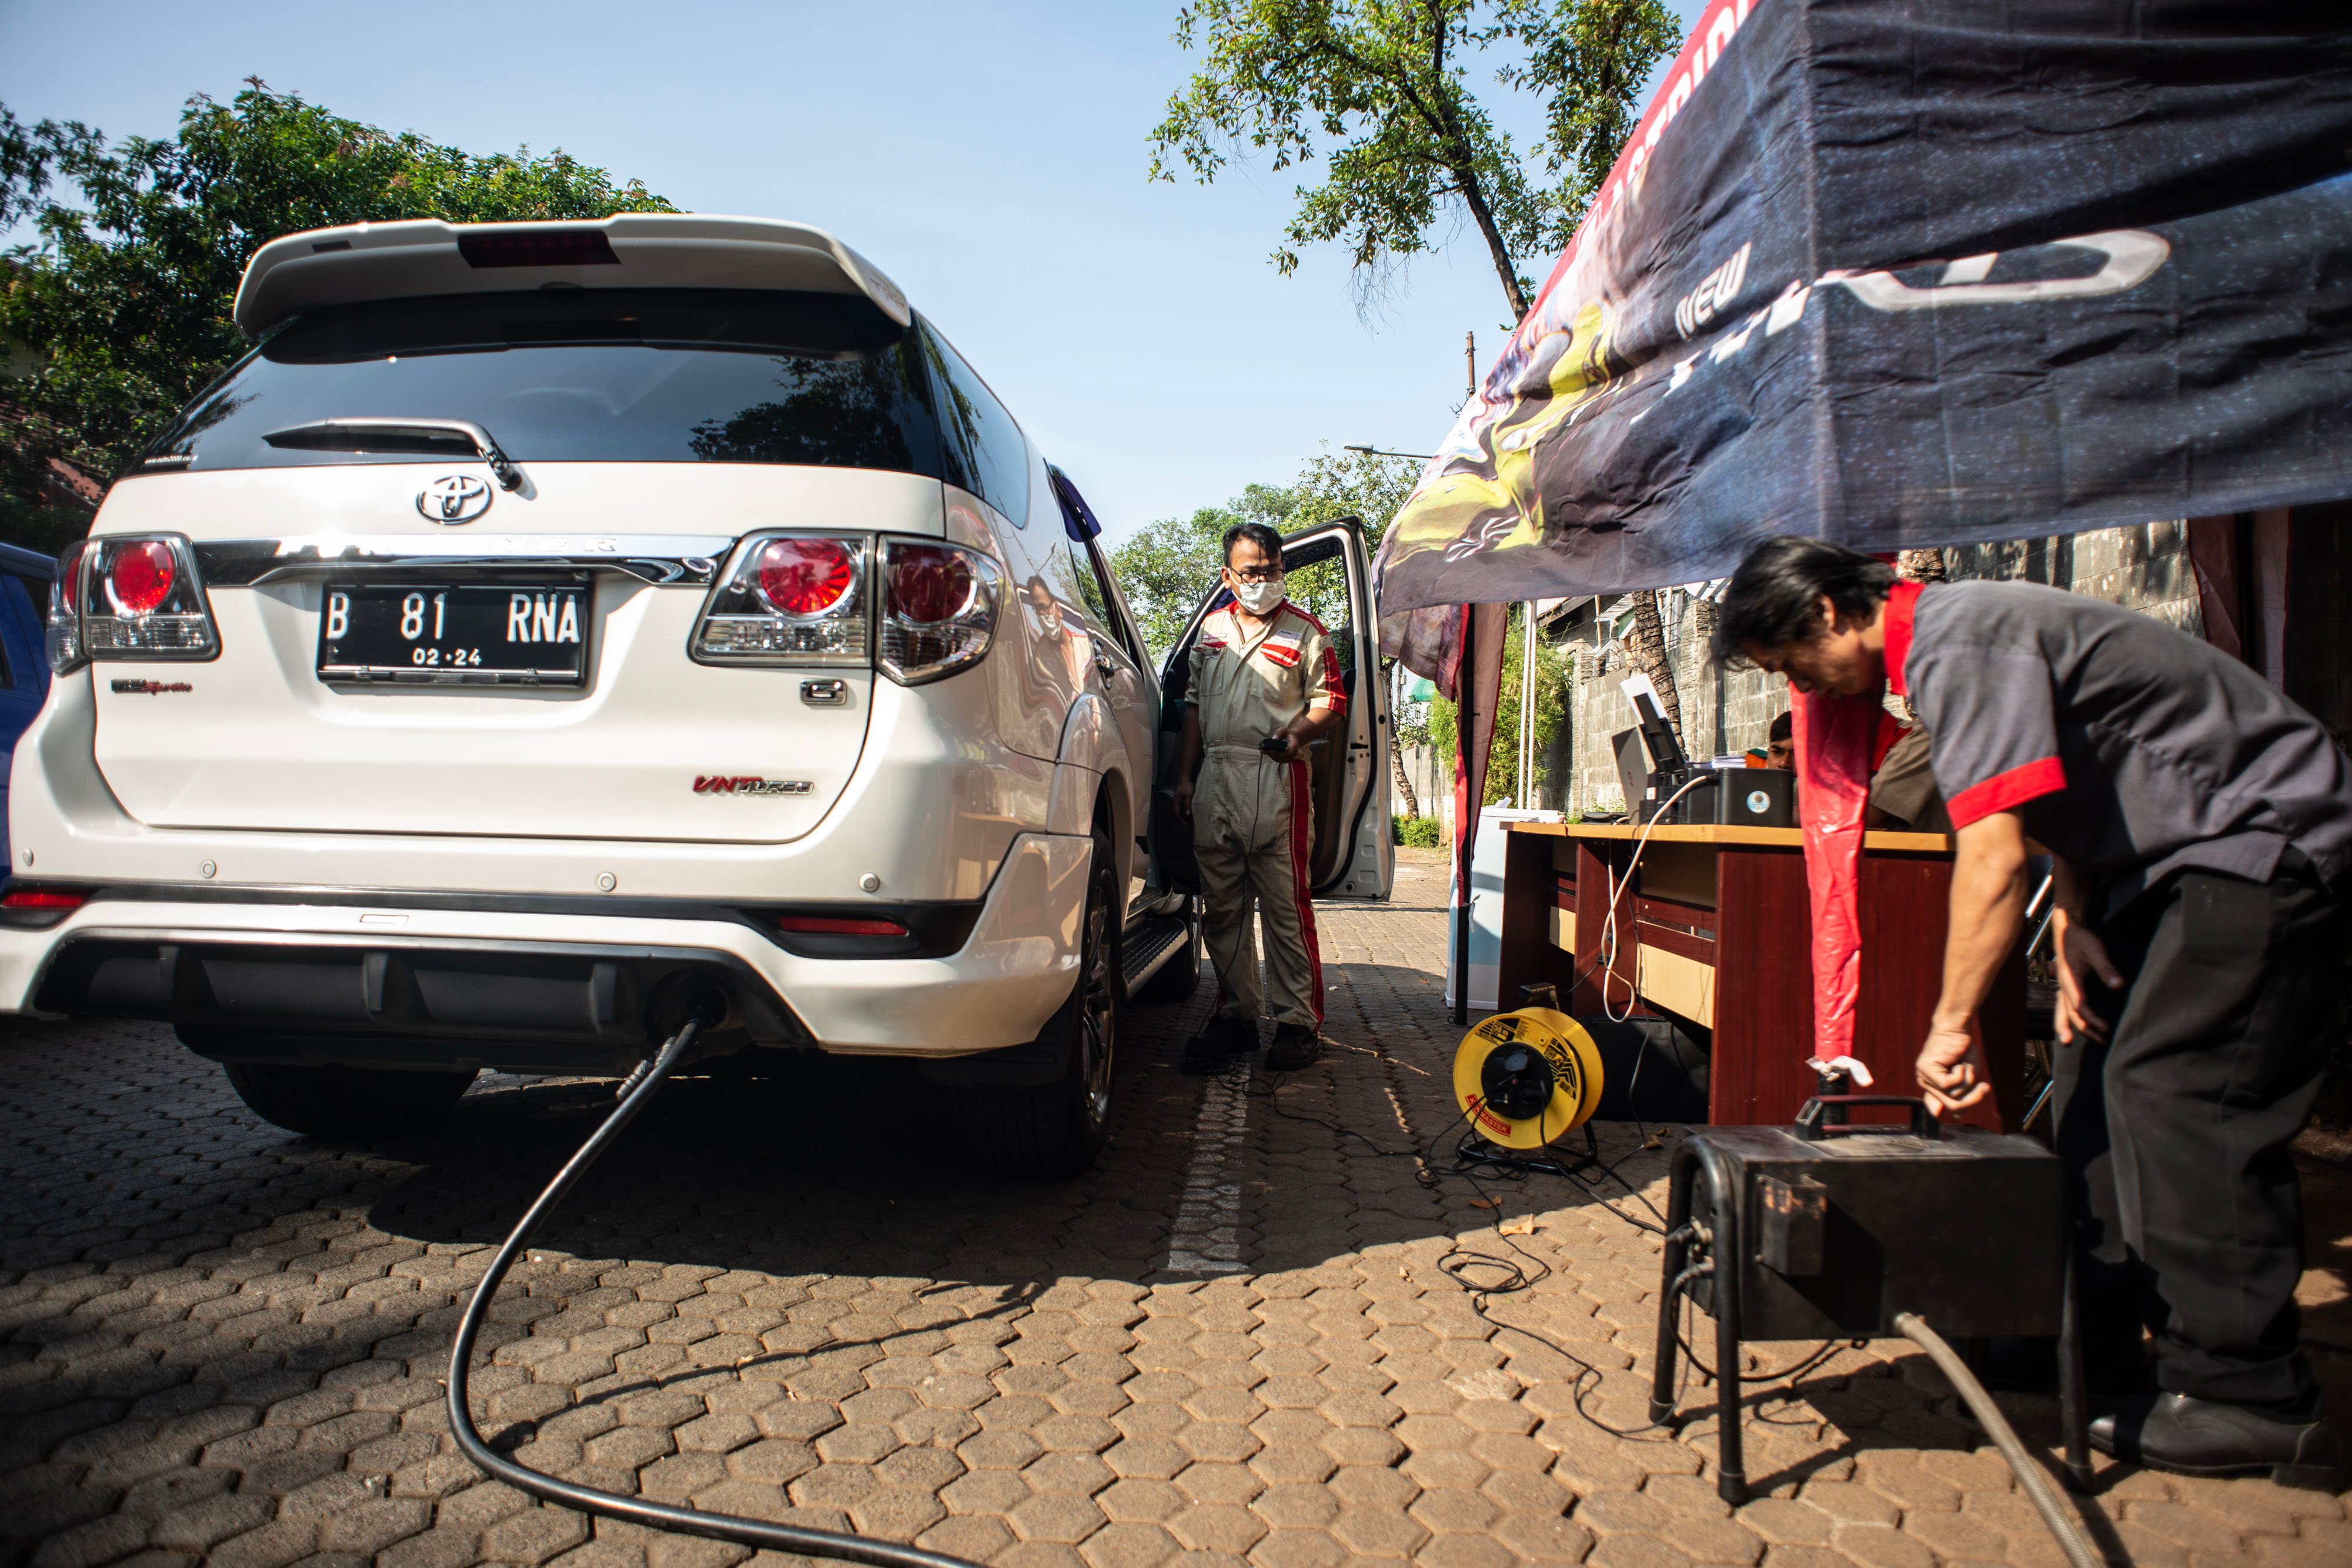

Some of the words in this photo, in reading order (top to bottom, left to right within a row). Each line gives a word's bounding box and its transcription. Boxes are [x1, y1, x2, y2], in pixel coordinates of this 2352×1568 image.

[1675, 241, 1751, 340] NEW
[326, 592, 350, 640] B
[400, 593, 446, 640] 81
[507, 594, 580, 643] RNA
